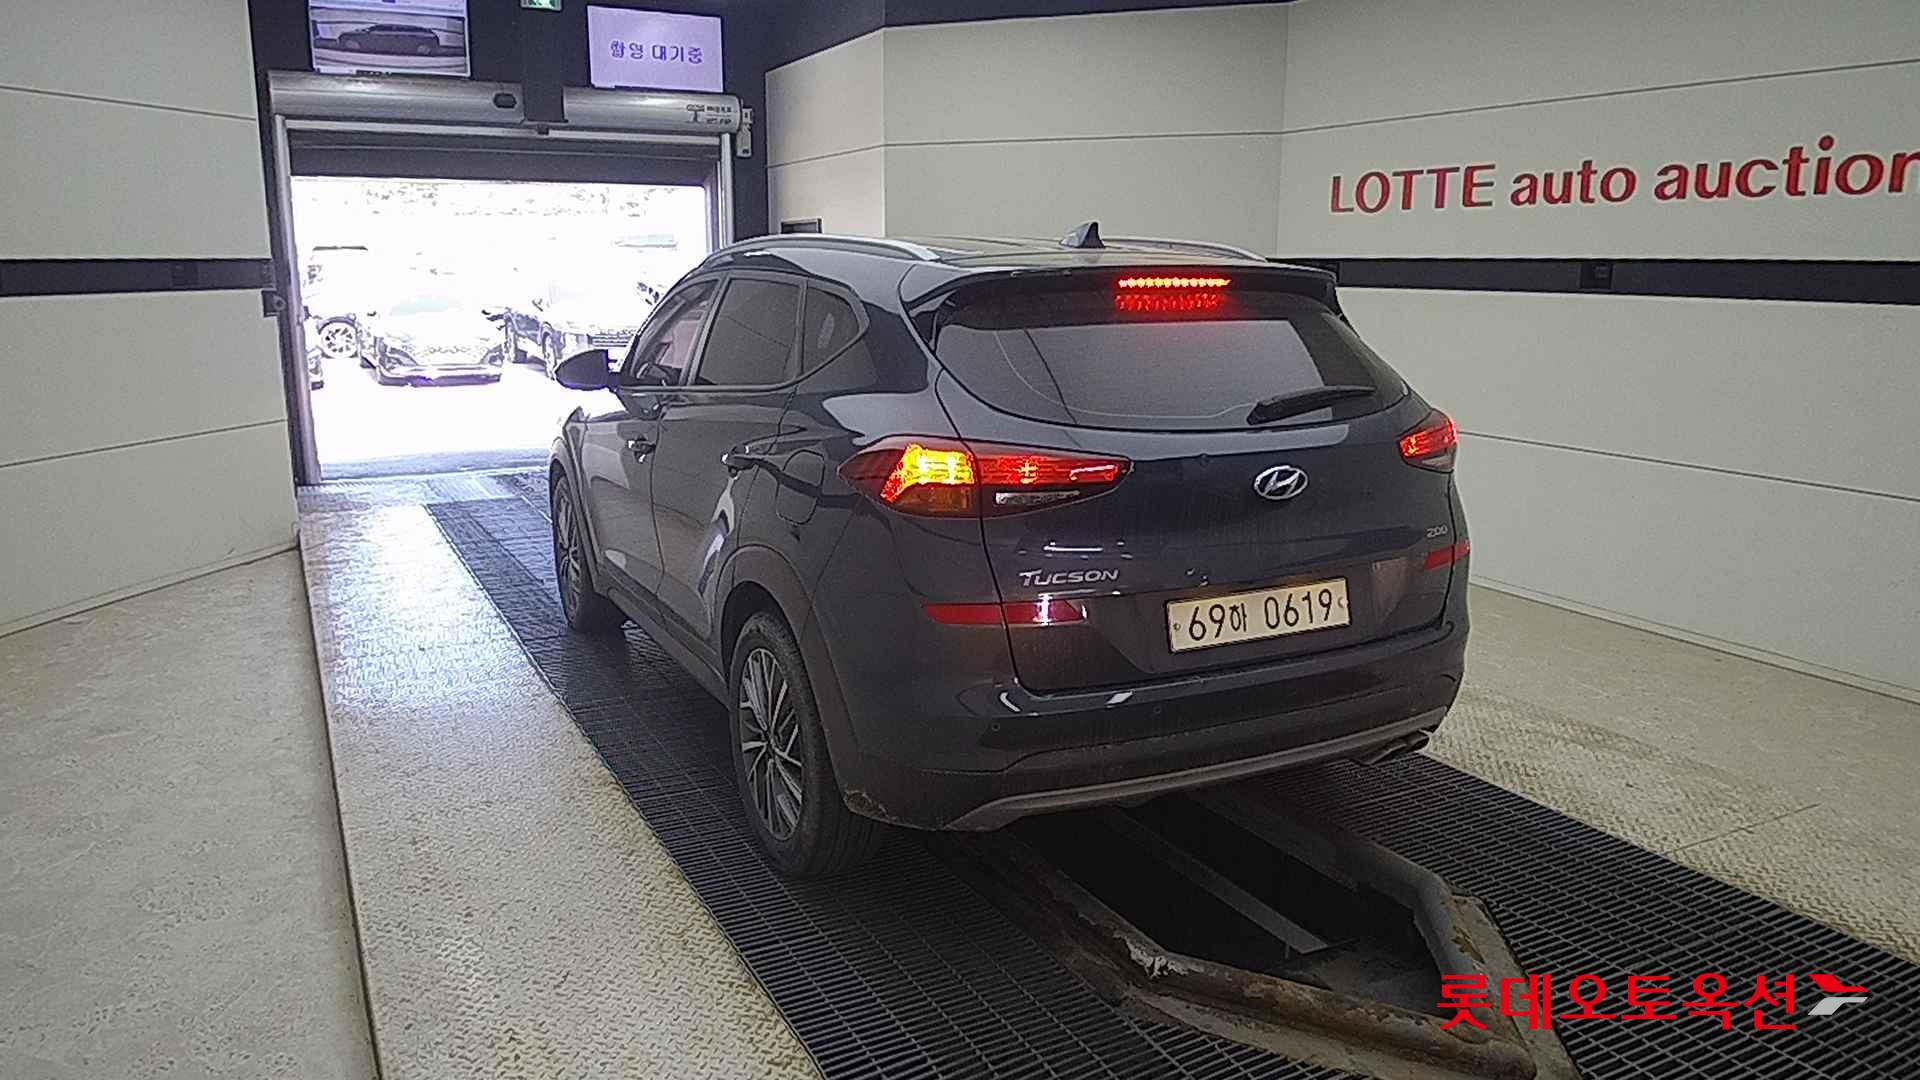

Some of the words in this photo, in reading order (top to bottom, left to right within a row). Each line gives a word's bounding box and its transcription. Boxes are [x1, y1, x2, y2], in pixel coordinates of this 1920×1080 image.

[1331, 165, 1495, 213] LOTTE
[1511, 160, 1636, 206] auto
[1188, 603, 1247, 641] 69하
[1264, 588, 1332, 629] 0619
